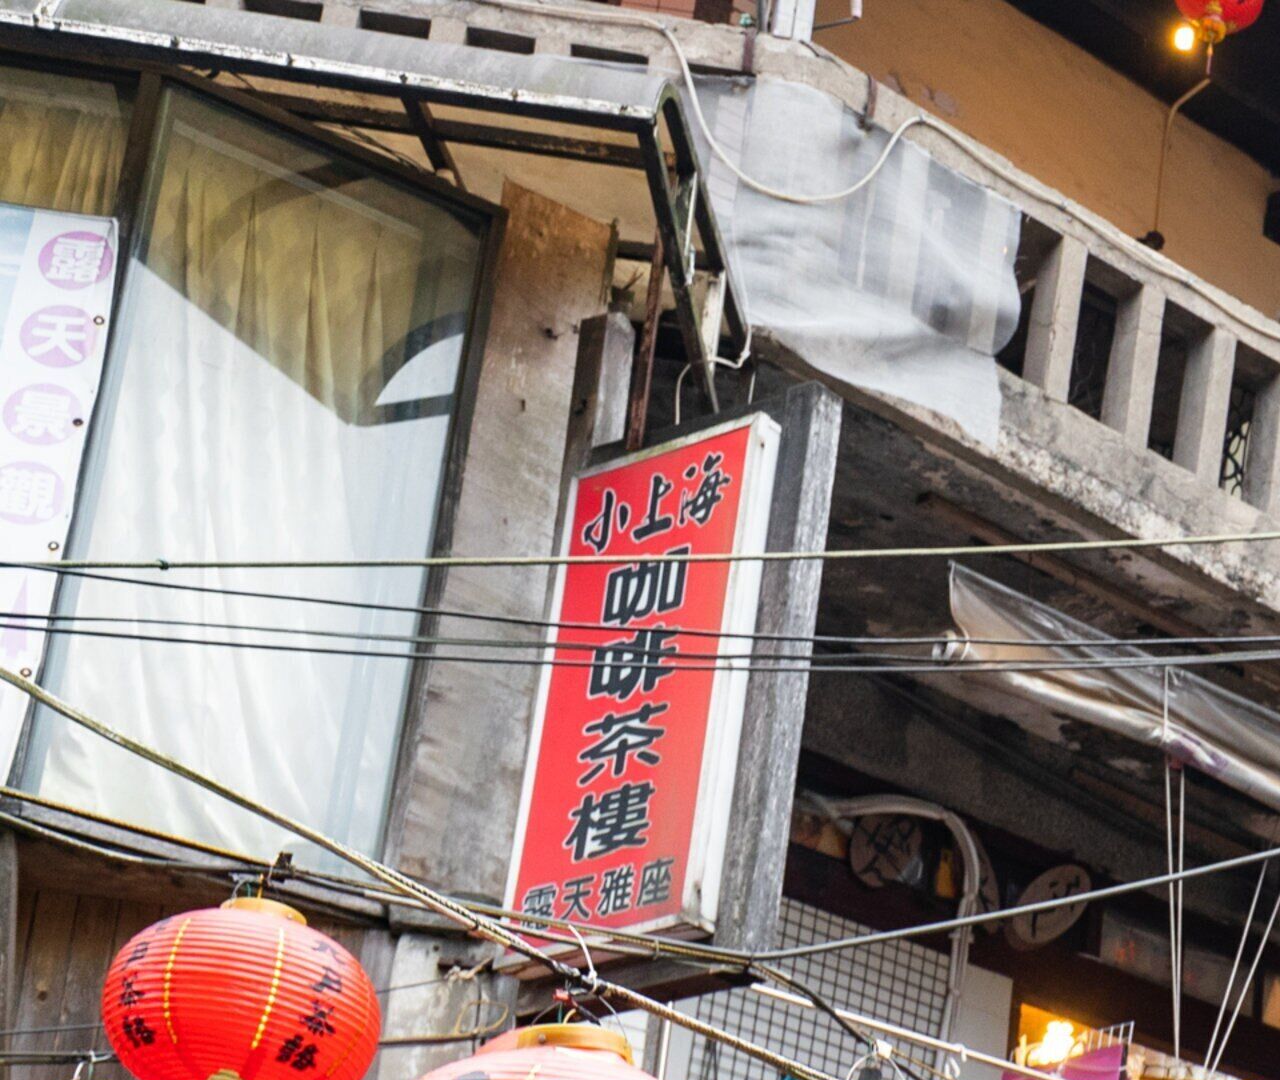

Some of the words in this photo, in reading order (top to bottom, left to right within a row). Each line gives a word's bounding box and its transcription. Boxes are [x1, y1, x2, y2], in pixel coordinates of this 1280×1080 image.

[583, 452, 732, 553] 小上海
[564, 546, 691, 862] 咖啡茶樓
[520, 856, 675, 930] 露天雅座
